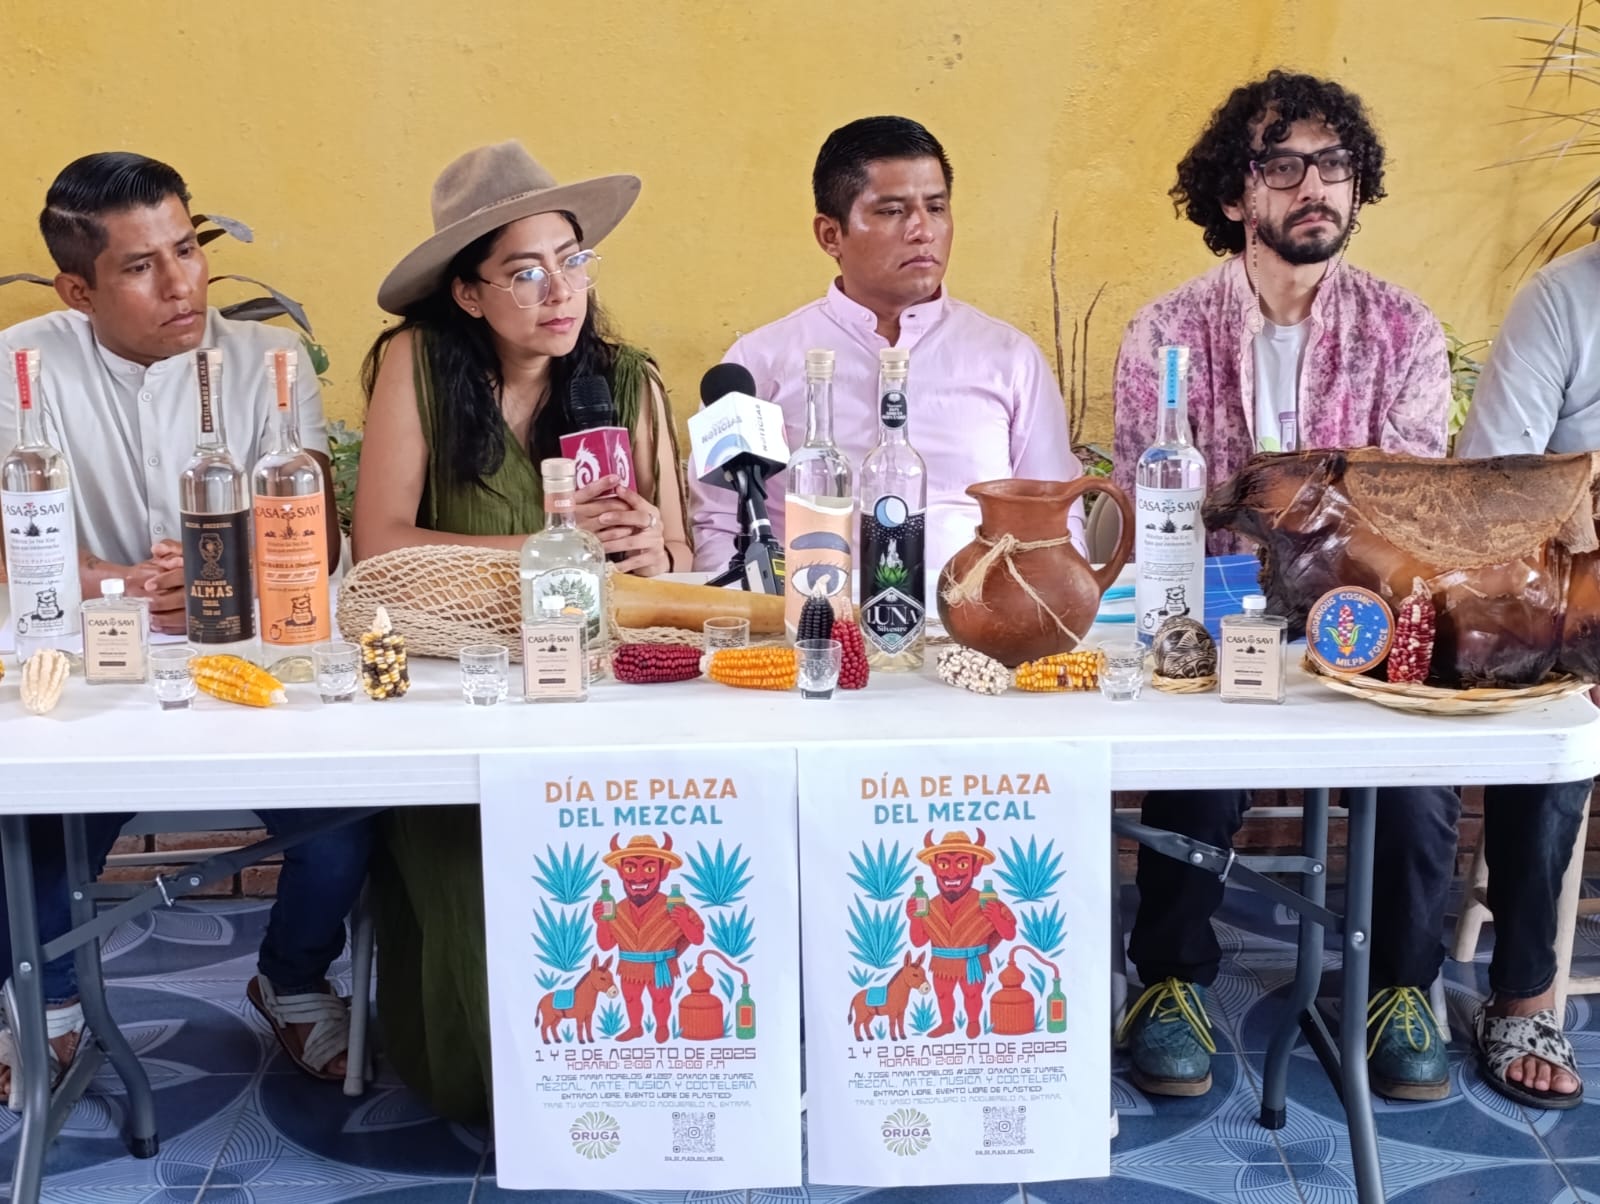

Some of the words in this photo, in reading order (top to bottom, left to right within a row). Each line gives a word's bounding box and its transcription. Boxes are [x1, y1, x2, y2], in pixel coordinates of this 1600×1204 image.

[3, 503, 23, 516] ASA
[40, 502, 65, 516] SAVI
[297, 505, 320, 518] SAVI
[1138, 499, 1161, 512] CASA
[1177, 500, 1200, 513] SAVI
[190, 586, 233, 598] ALMAS
[1339, 592, 1374, 607] COSMIC
[867, 605, 917, 625] LUNA
[1311, 596, 1336, 644] INDIGENOUS
[528, 636, 548, 644] CASA
[557, 635, 574, 643] SAVI
[1226, 636, 1247, 644] CASA
[1255, 637, 1273, 645] SAVI
[1368, 628, 1388, 658] FORCE
[1335, 656, 1366, 667] MILPA
[545, 776, 595, 803] DÍA
[606, 779, 639, 801] DE
[649, 778, 738, 801] PLAZA
[861, 772, 910, 799] DÍA
[920, 776, 953, 798] DE
[963, 773, 1051, 796] PLAZA
[559, 807, 605, 828] DEL
[613, 805, 723, 826] MEZCAL
[874, 803, 919, 824] DEL
[928, 800, 1036, 823] MEZCAL
[565, 1049, 577, 1061] 2
[582, 1049, 603, 1061] DE
[609, 1047, 679, 1060] AGOSTO
[685, 1047, 705, 1060] DE
[710, 1047, 757, 1060] 2025
[877, 1046, 889, 1058] 2
[894, 1045, 915, 1058] DE
[921, 1043, 990, 1057] AGOSTO
[995, 1042, 1016, 1055] DE
[1022, 1041, 1067, 1054] 2025
[623, 1060, 652, 1070] 2:00
[668, 1060, 702, 1069] 10:00
[935, 1056, 963, 1066] 2:00
[979, 1054, 1013, 1064] 10:00
[571, 1131, 620, 1141] ORUGA
[882, 1127, 931, 1138] ORUGA
